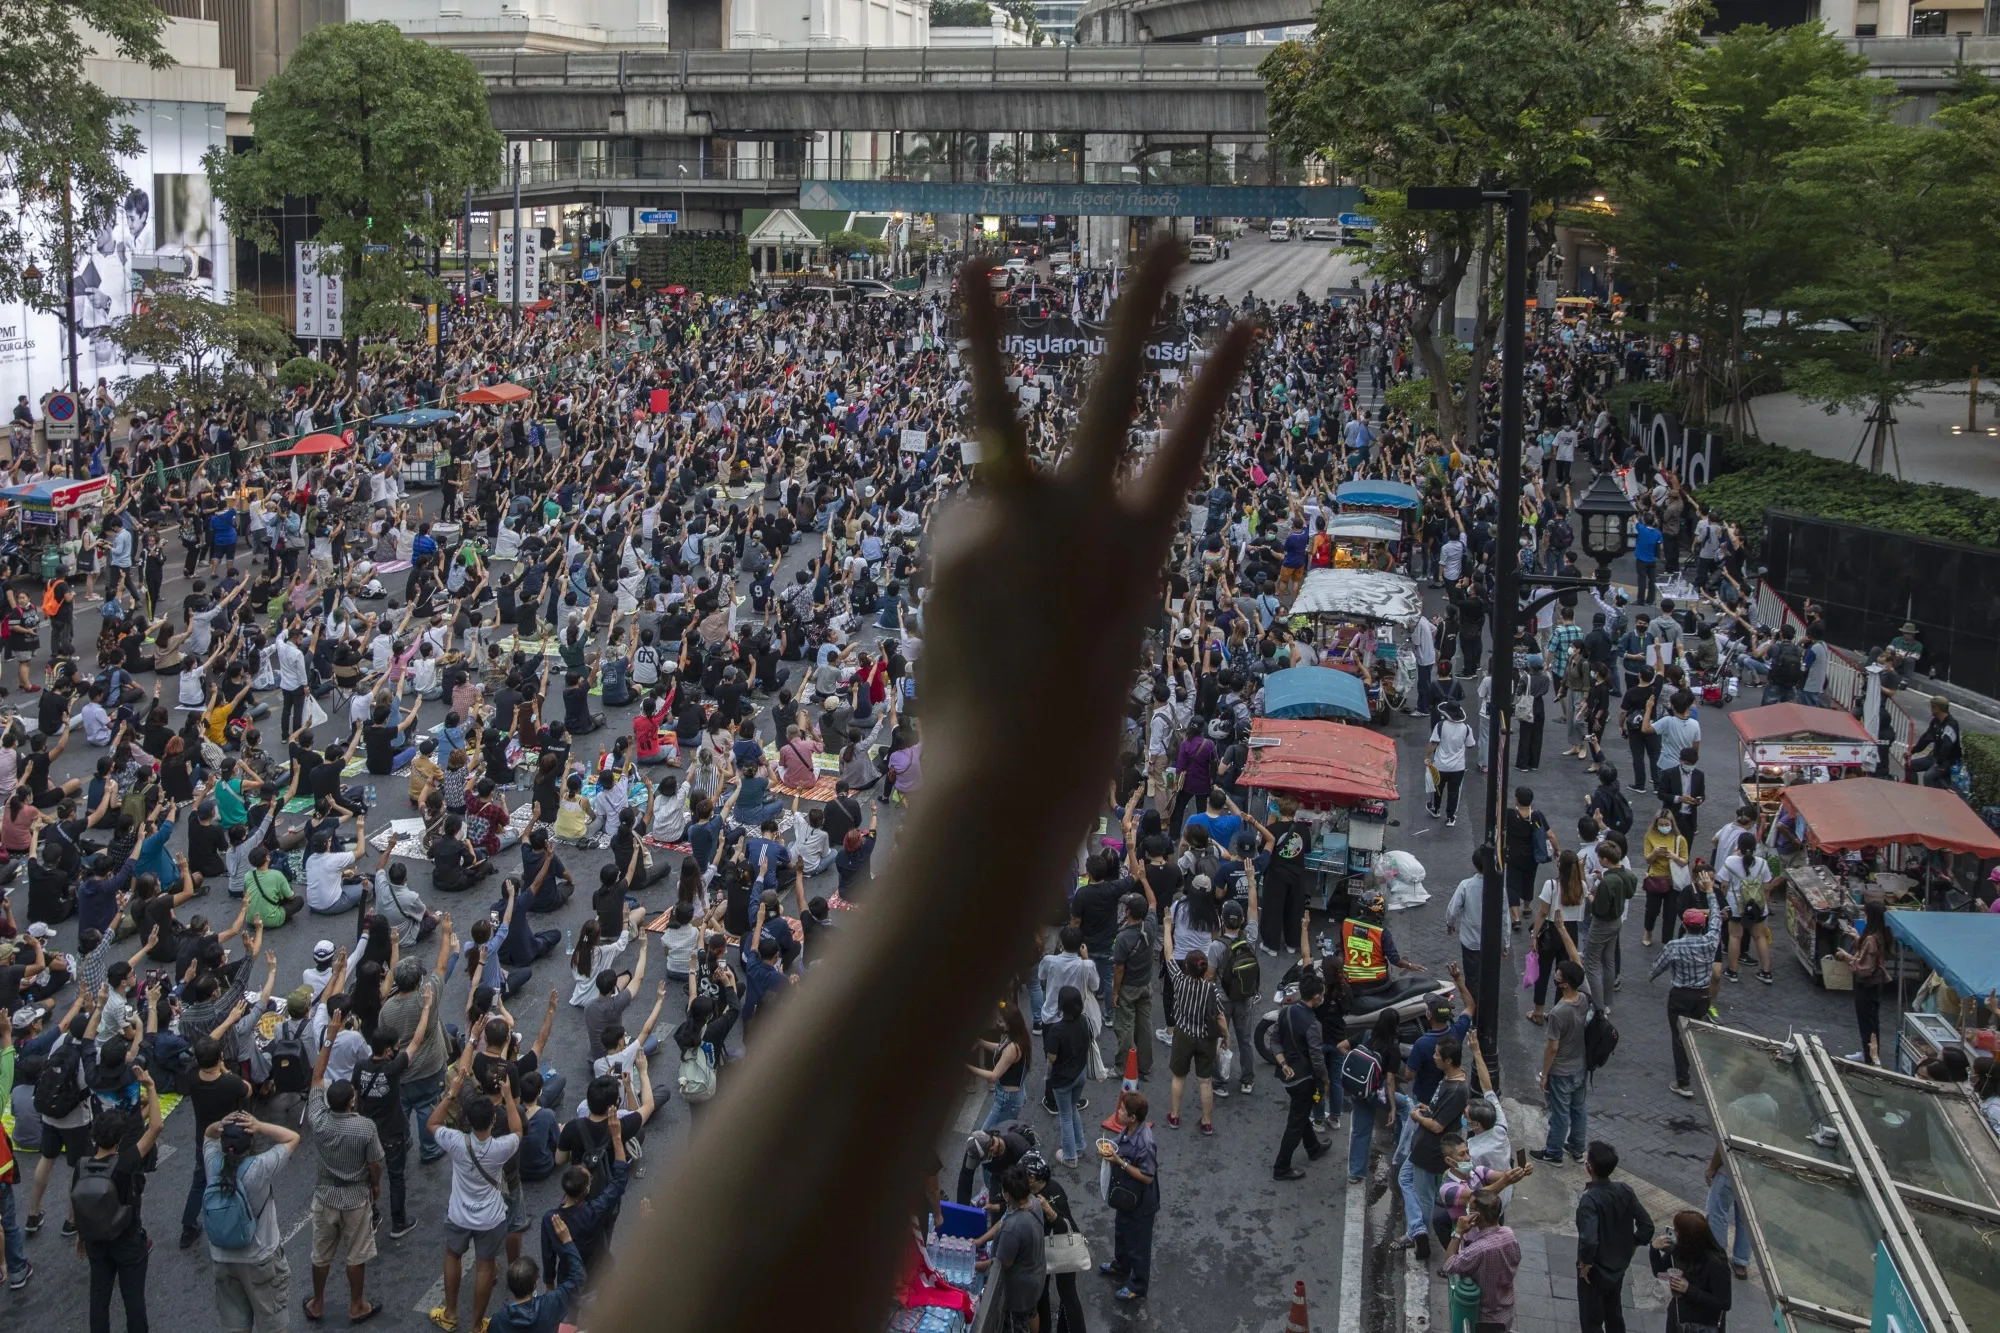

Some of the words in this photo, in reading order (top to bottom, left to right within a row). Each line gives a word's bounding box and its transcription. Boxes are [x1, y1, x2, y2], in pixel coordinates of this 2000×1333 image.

[14, 340, 35, 350] GLASS
[754, 584, 763, 598] 9
[1349, 948, 1372, 967] 23
